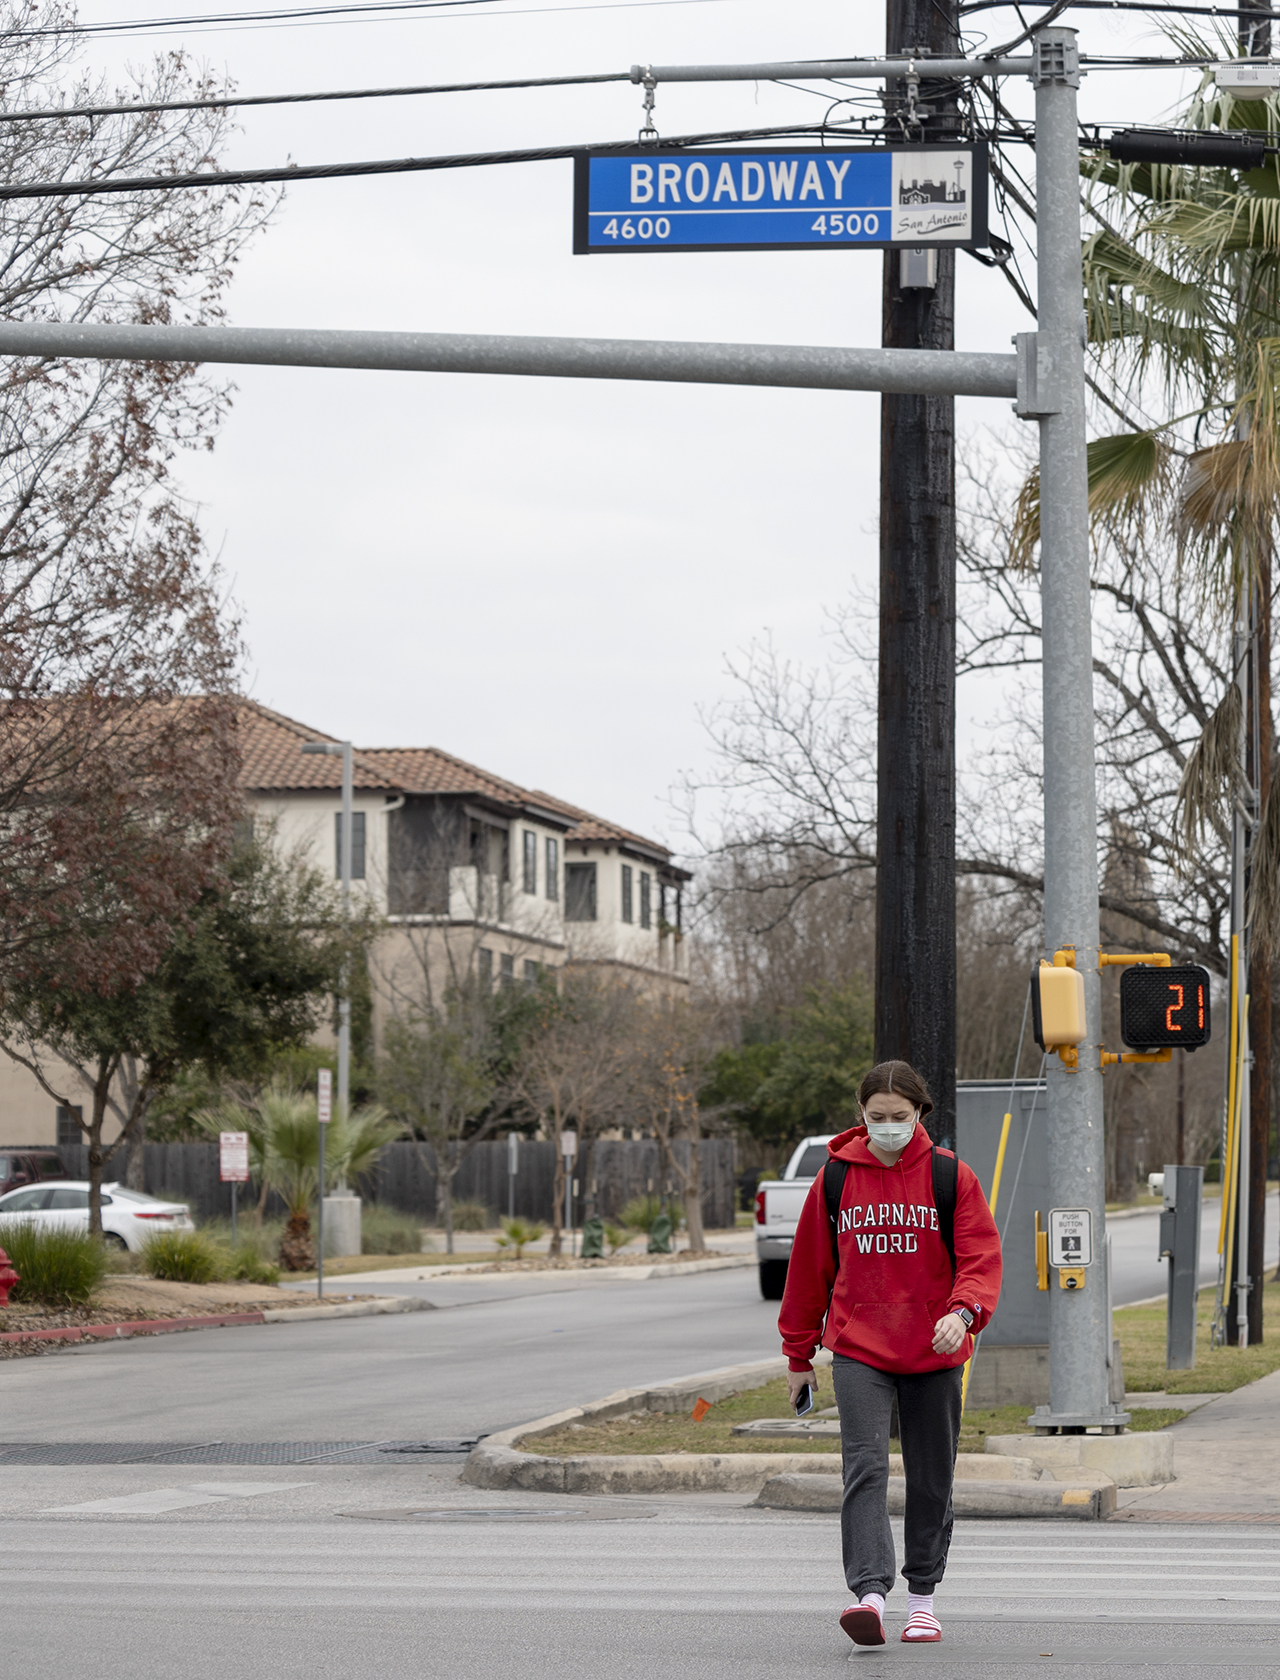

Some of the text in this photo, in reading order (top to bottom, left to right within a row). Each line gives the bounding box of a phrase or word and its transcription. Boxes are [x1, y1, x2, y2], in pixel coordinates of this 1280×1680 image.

[630, 160, 851, 203] BROADWAY
[602, 213, 879, 239] 4600 4500
[897, 212, 968, 234] San Antonio
[1165, 984, 1204, 1031] 21
[855, 1233, 918, 1254] WORD
